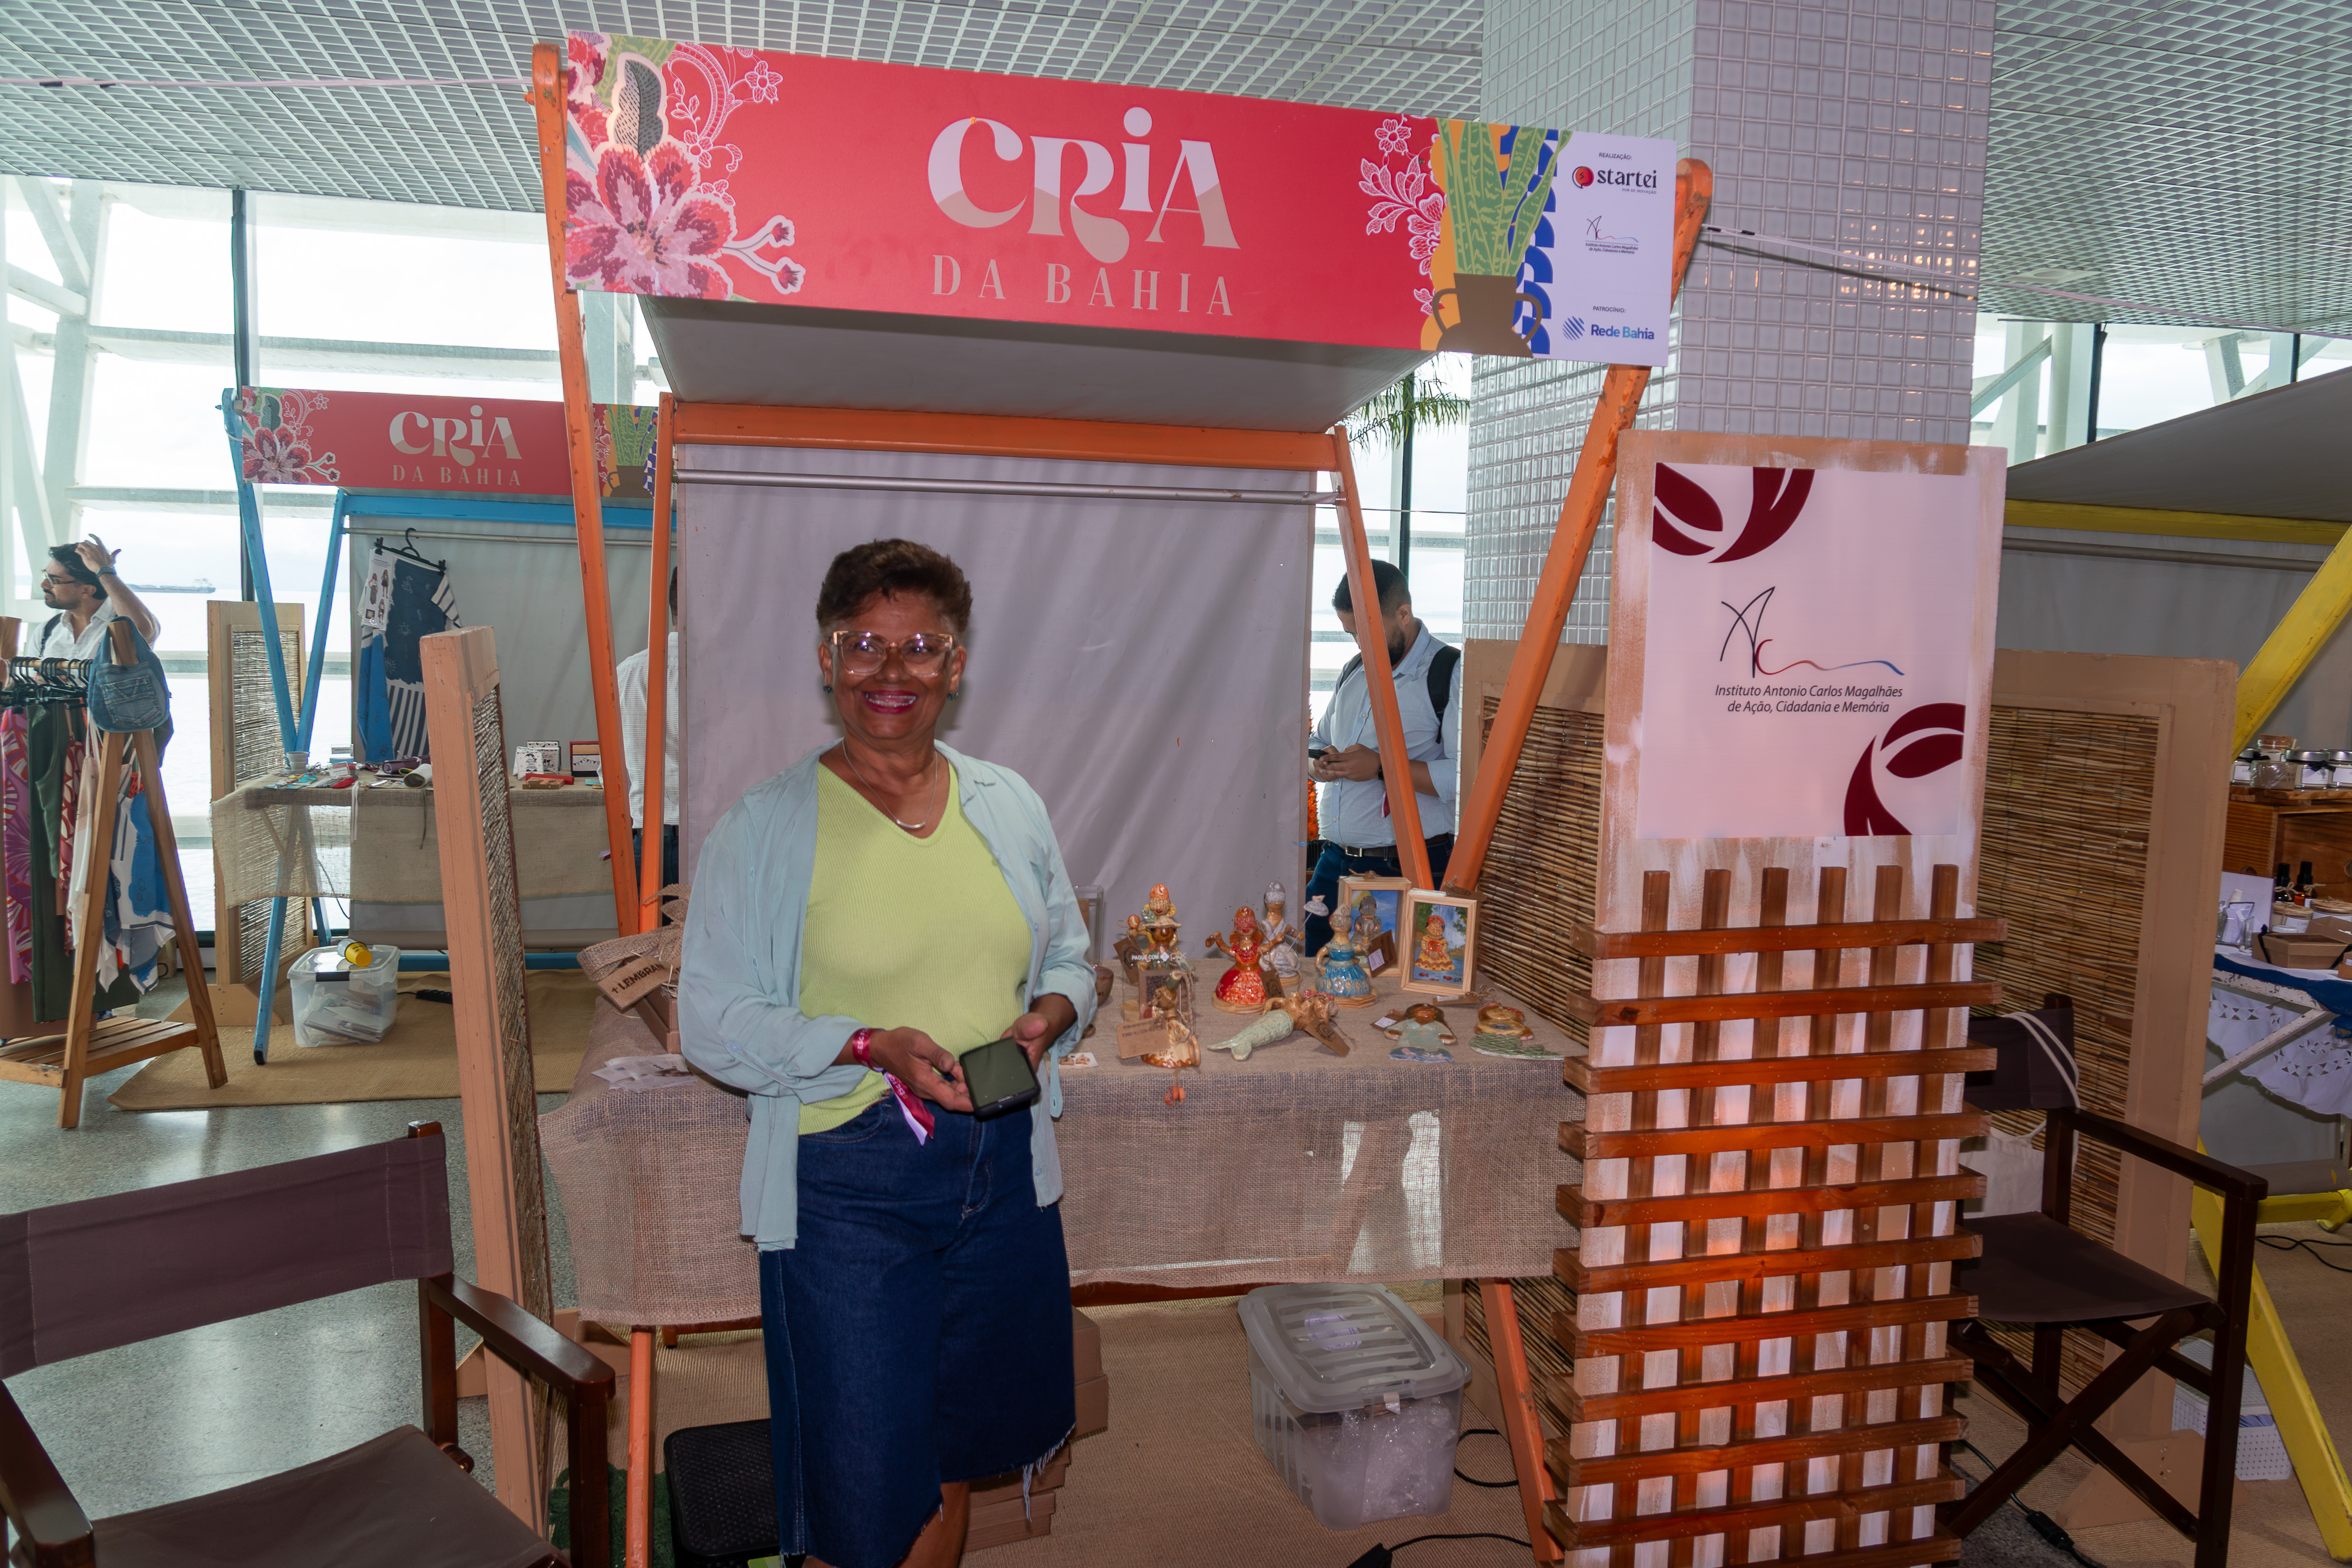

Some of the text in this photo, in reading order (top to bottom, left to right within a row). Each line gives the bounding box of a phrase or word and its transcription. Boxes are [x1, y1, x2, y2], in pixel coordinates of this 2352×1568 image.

[1597, 168, 1657, 188] startei
[933, 255, 1232, 315] DA BAHIA
[1591, 324, 1655, 339] Rede Bahia
[393, 464, 520, 486] DA BAHIA
[1715, 684, 1903, 700] Instituto Antonio Carlos Magalhães
[1728, 700, 1889, 714] de Ação, Cidadania e Memória
[618, 963, 680, 990] LEMBRAN
